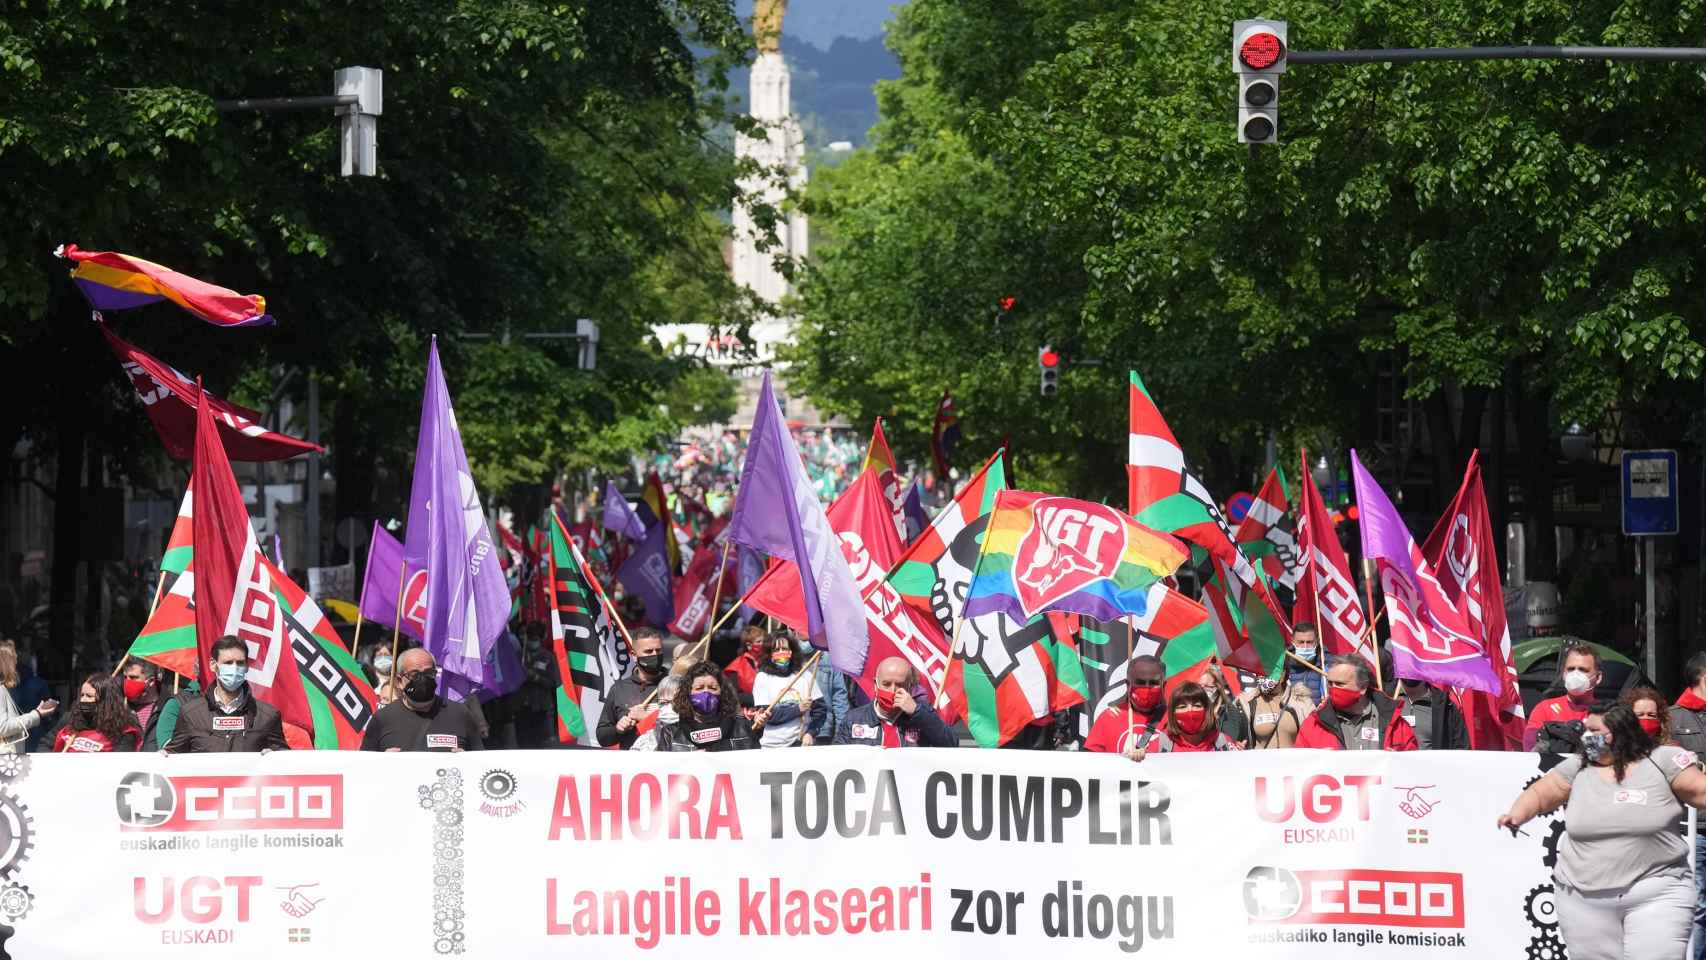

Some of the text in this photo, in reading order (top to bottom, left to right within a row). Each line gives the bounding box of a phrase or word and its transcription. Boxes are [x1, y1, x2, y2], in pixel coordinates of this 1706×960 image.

[1034, 506, 1119, 565] UGT
[287, 622, 364, 720] COO
[185, 785, 332, 821] CCOO
[547, 769, 1174, 845] AHORA TOCA CUMPLIR
[1255, 774, 1382, 823] UGT
[120, 834, 344, 852] euskadiko langile komisioak
[1284, 828, 1355, 844] EUSKADI
[133, 876, 263, 924] UGT
[546, 872, 1175, 953] Langile klaseari zor diogu
[1310, 880, 1454, 917] CCOO
[161, 929, 234, 945] EUSKADI
[1248, 928, 1466, 947] euskadiko langile komisioak
